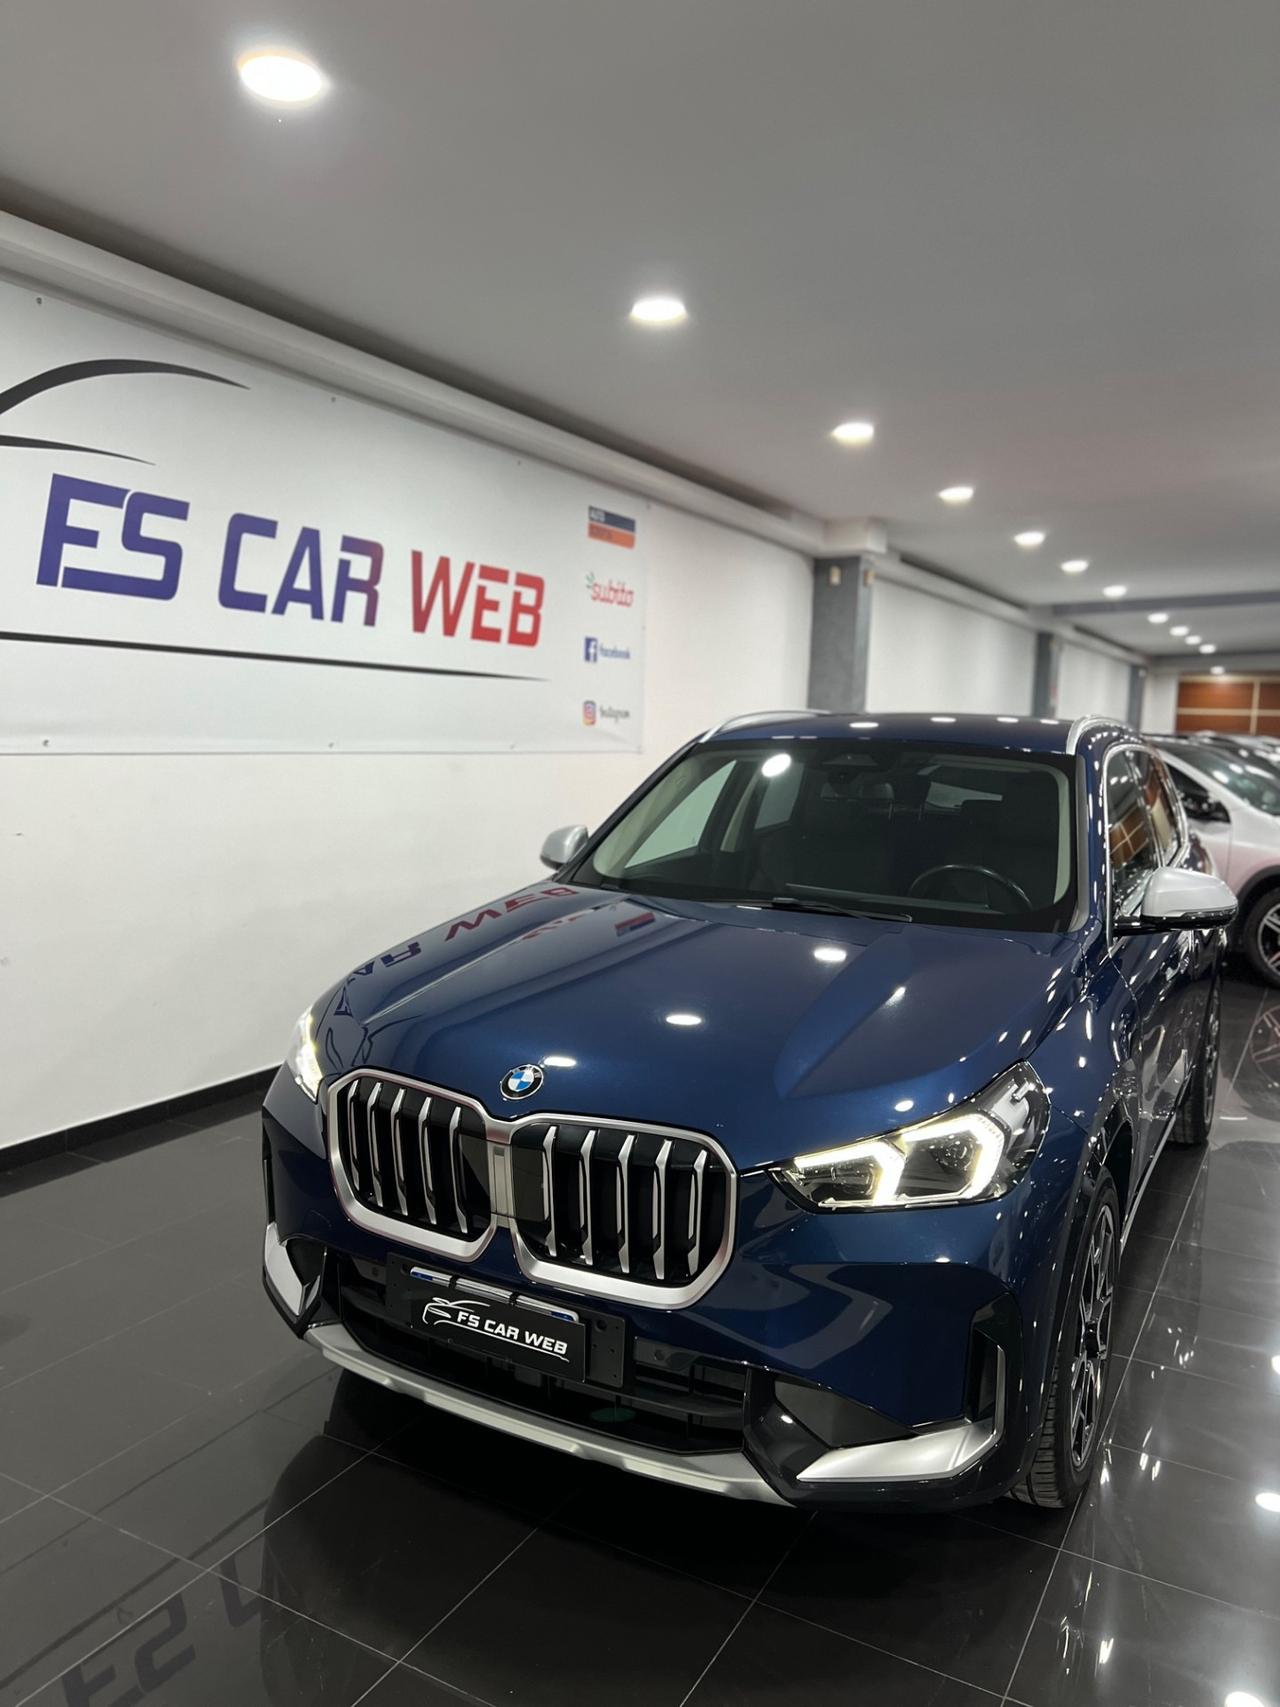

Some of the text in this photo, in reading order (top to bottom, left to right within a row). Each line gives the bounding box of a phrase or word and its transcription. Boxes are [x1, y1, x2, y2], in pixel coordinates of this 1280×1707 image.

[218, 513, 384, 627] CAR
[411, 550, 545, 648] WEB
[456, 1310, 568, 1355] FS CAR WEB
